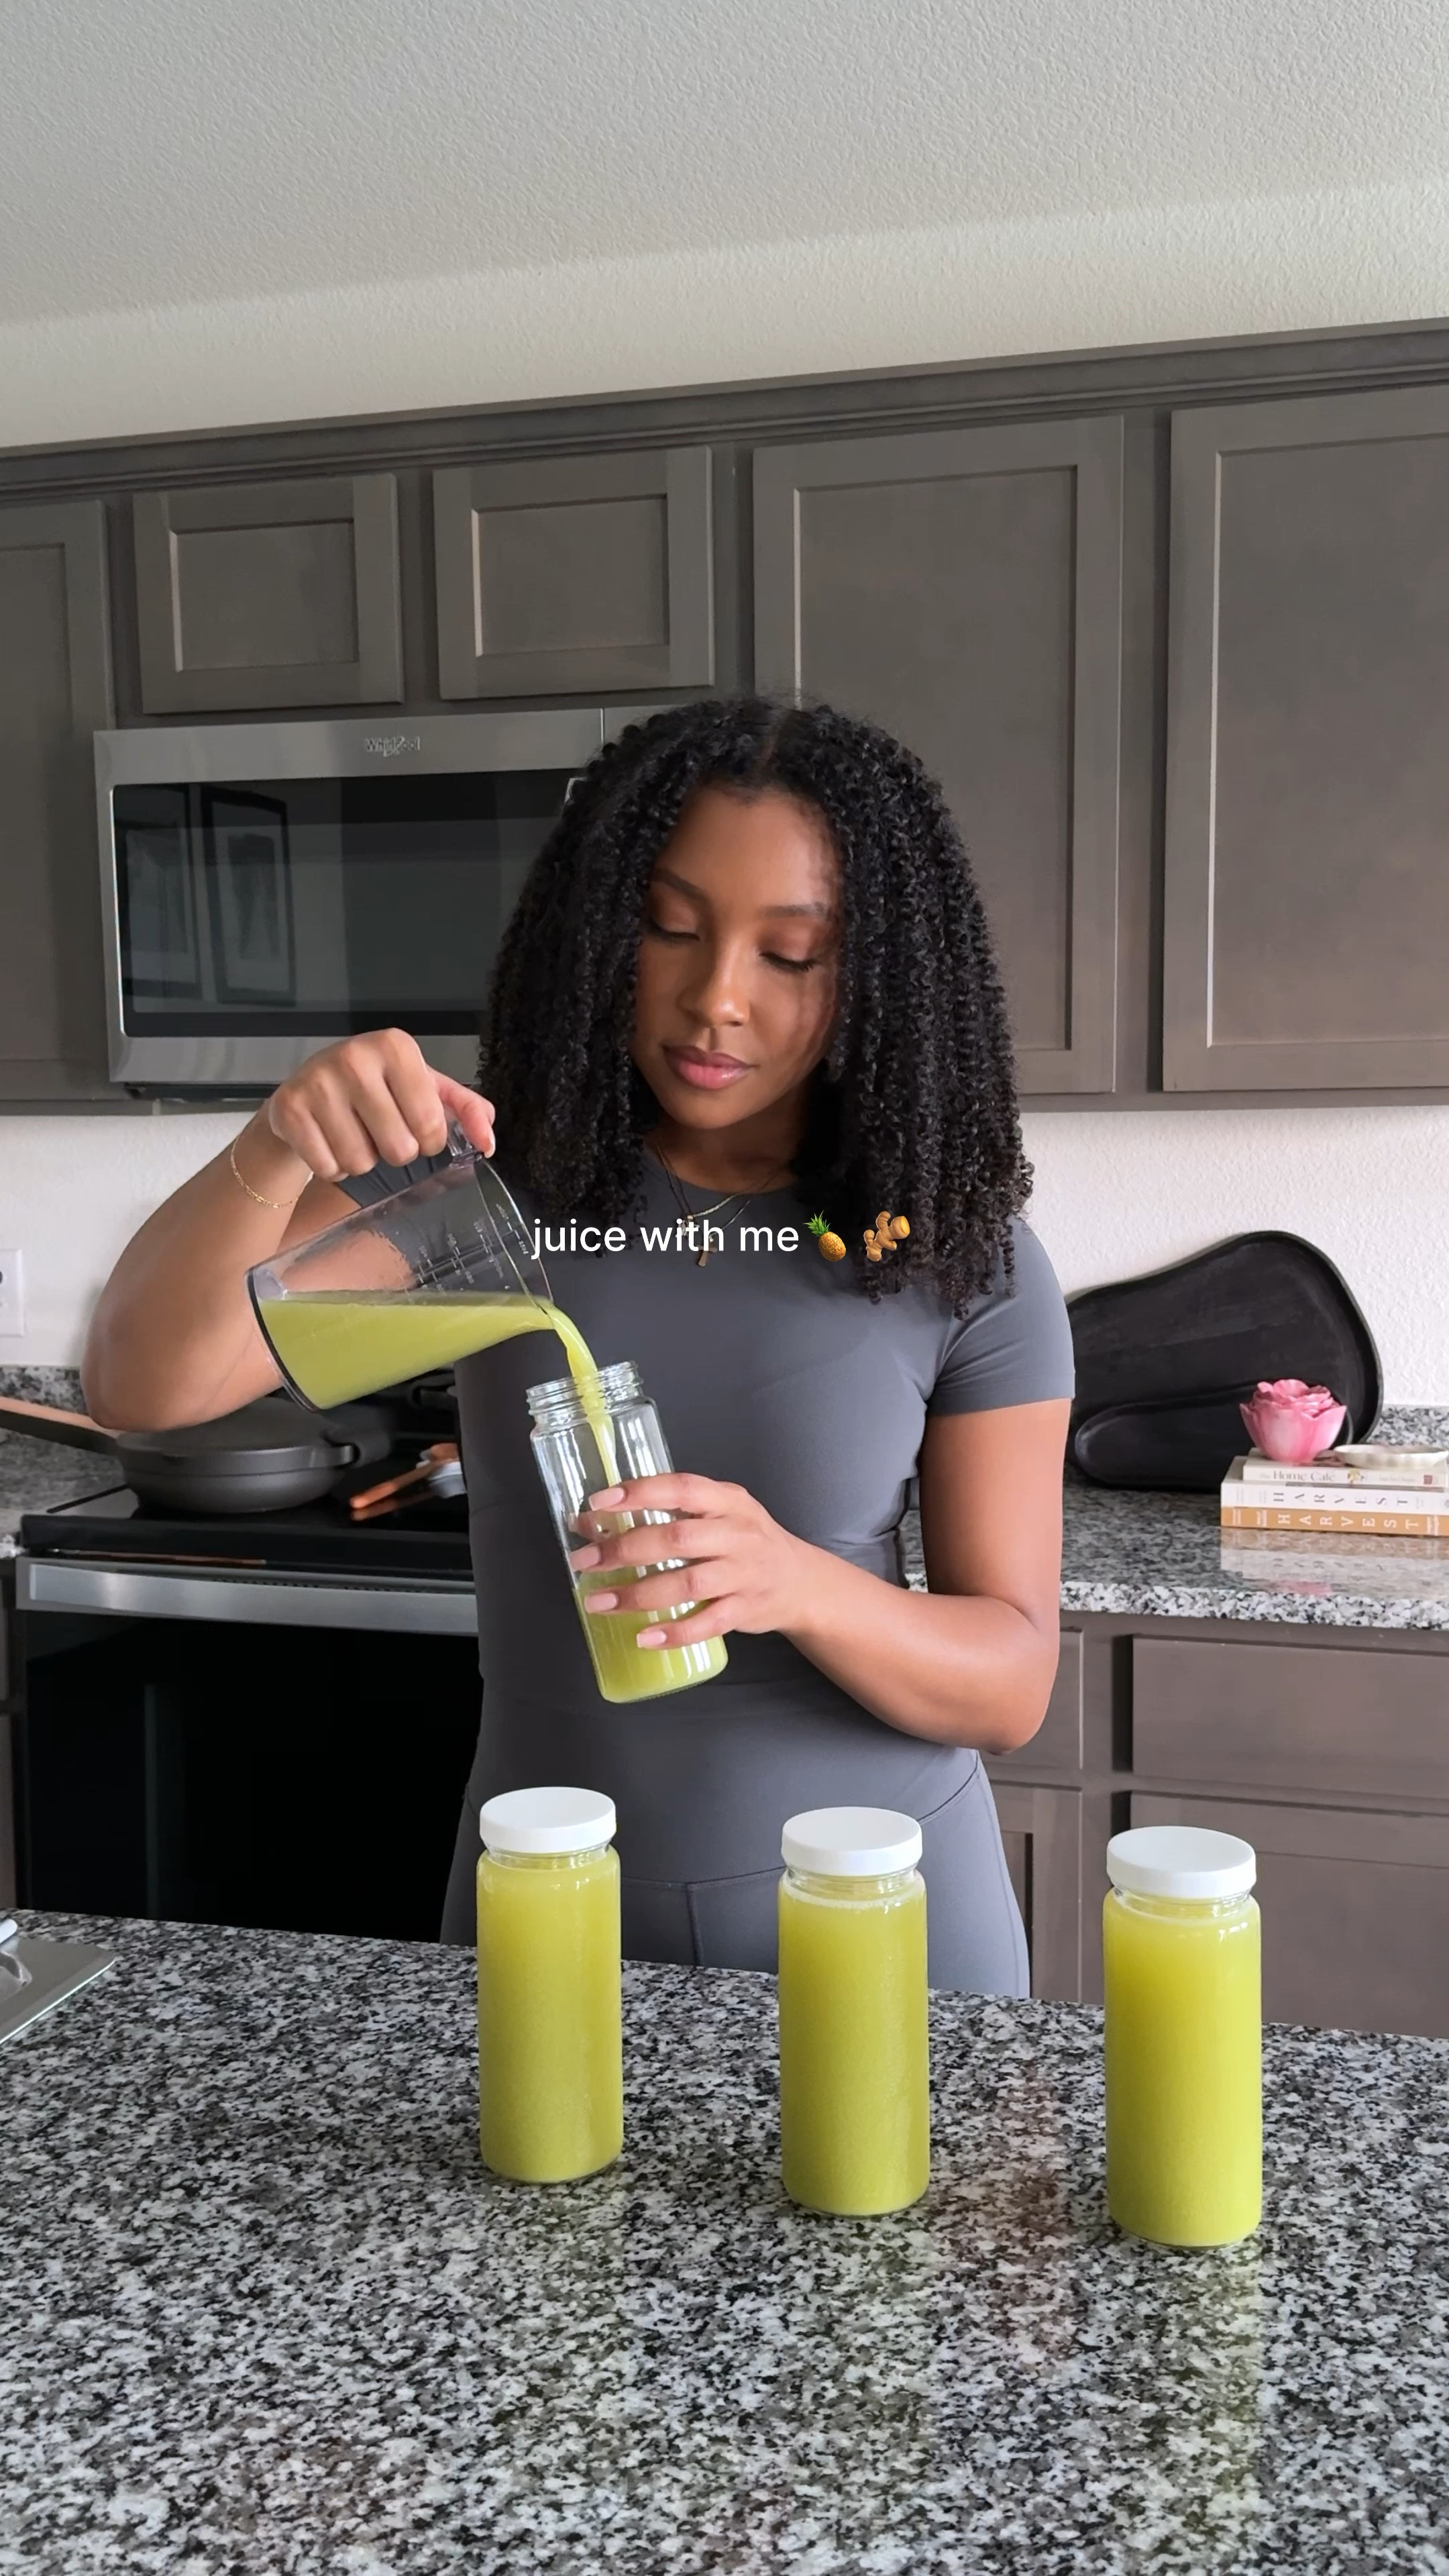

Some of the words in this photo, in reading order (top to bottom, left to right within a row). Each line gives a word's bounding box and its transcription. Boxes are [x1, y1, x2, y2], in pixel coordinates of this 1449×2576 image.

[364, 735, 421, 757] Whirlpool
[1273, 1470, 1306, 1481] Home
[1273, 1492, 1408, 1507] HARVEST
[1278, 1513, 1419, 1530] HARVEST
